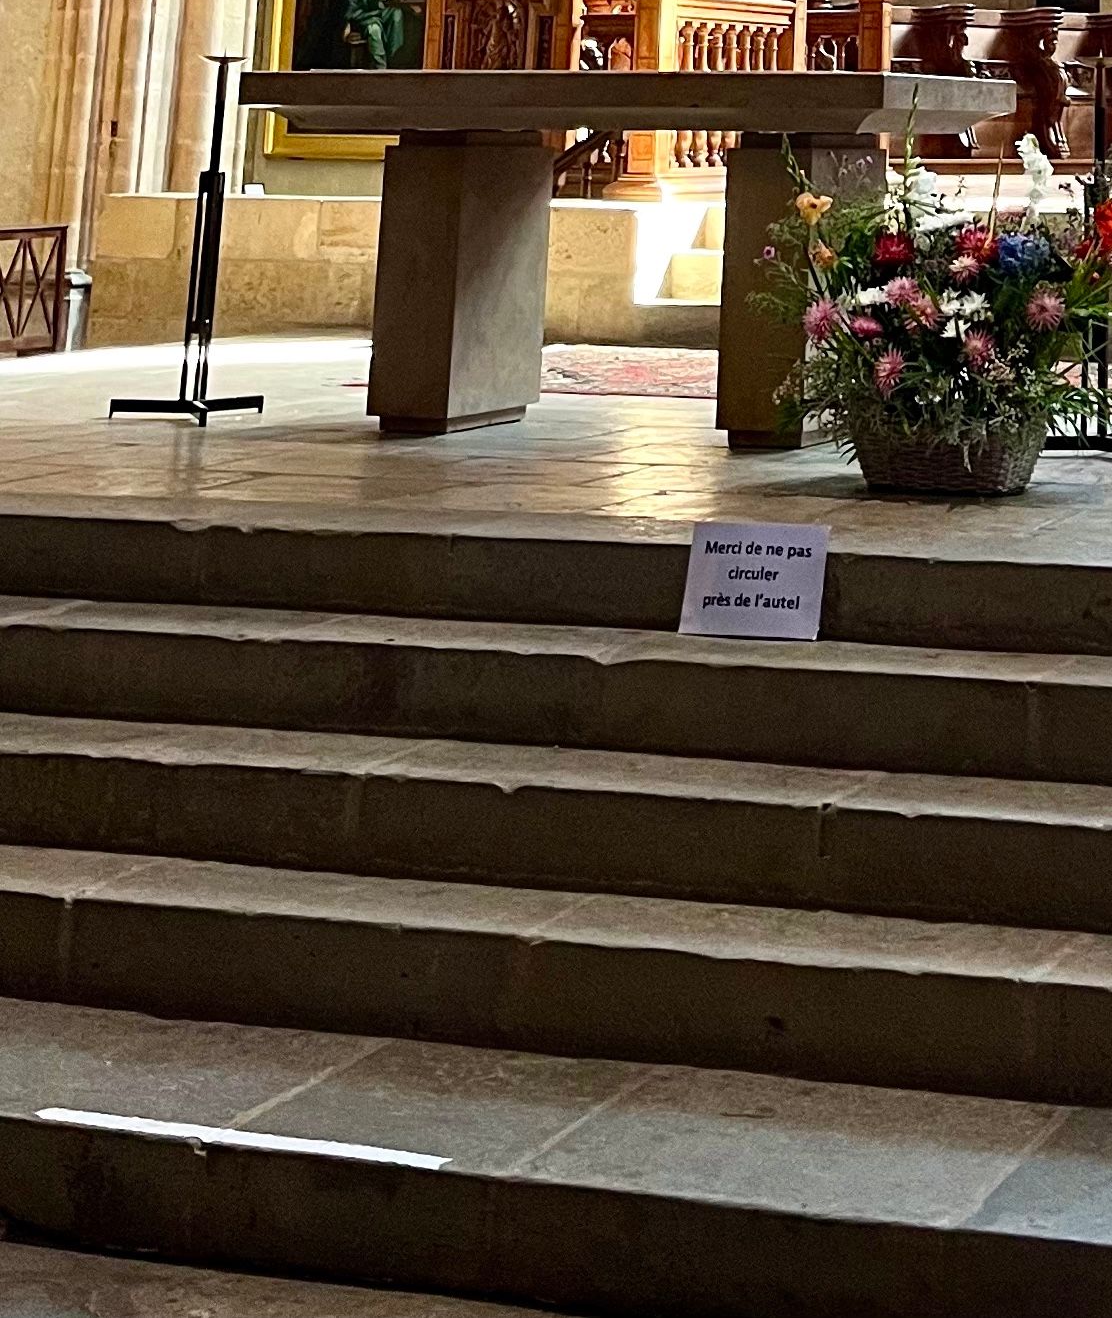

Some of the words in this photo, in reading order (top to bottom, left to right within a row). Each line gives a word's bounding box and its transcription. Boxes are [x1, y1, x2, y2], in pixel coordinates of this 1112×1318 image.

[705, 541, 742, 555] Merci
[746, 541, 762, 555] de
[766, 545, 783, 556] ne
[787, 546, 812, 559] pas
[728, 566, 779, 581] circuler
[703, 592, 730, 609] près
[735, 593, 750, 607] de
